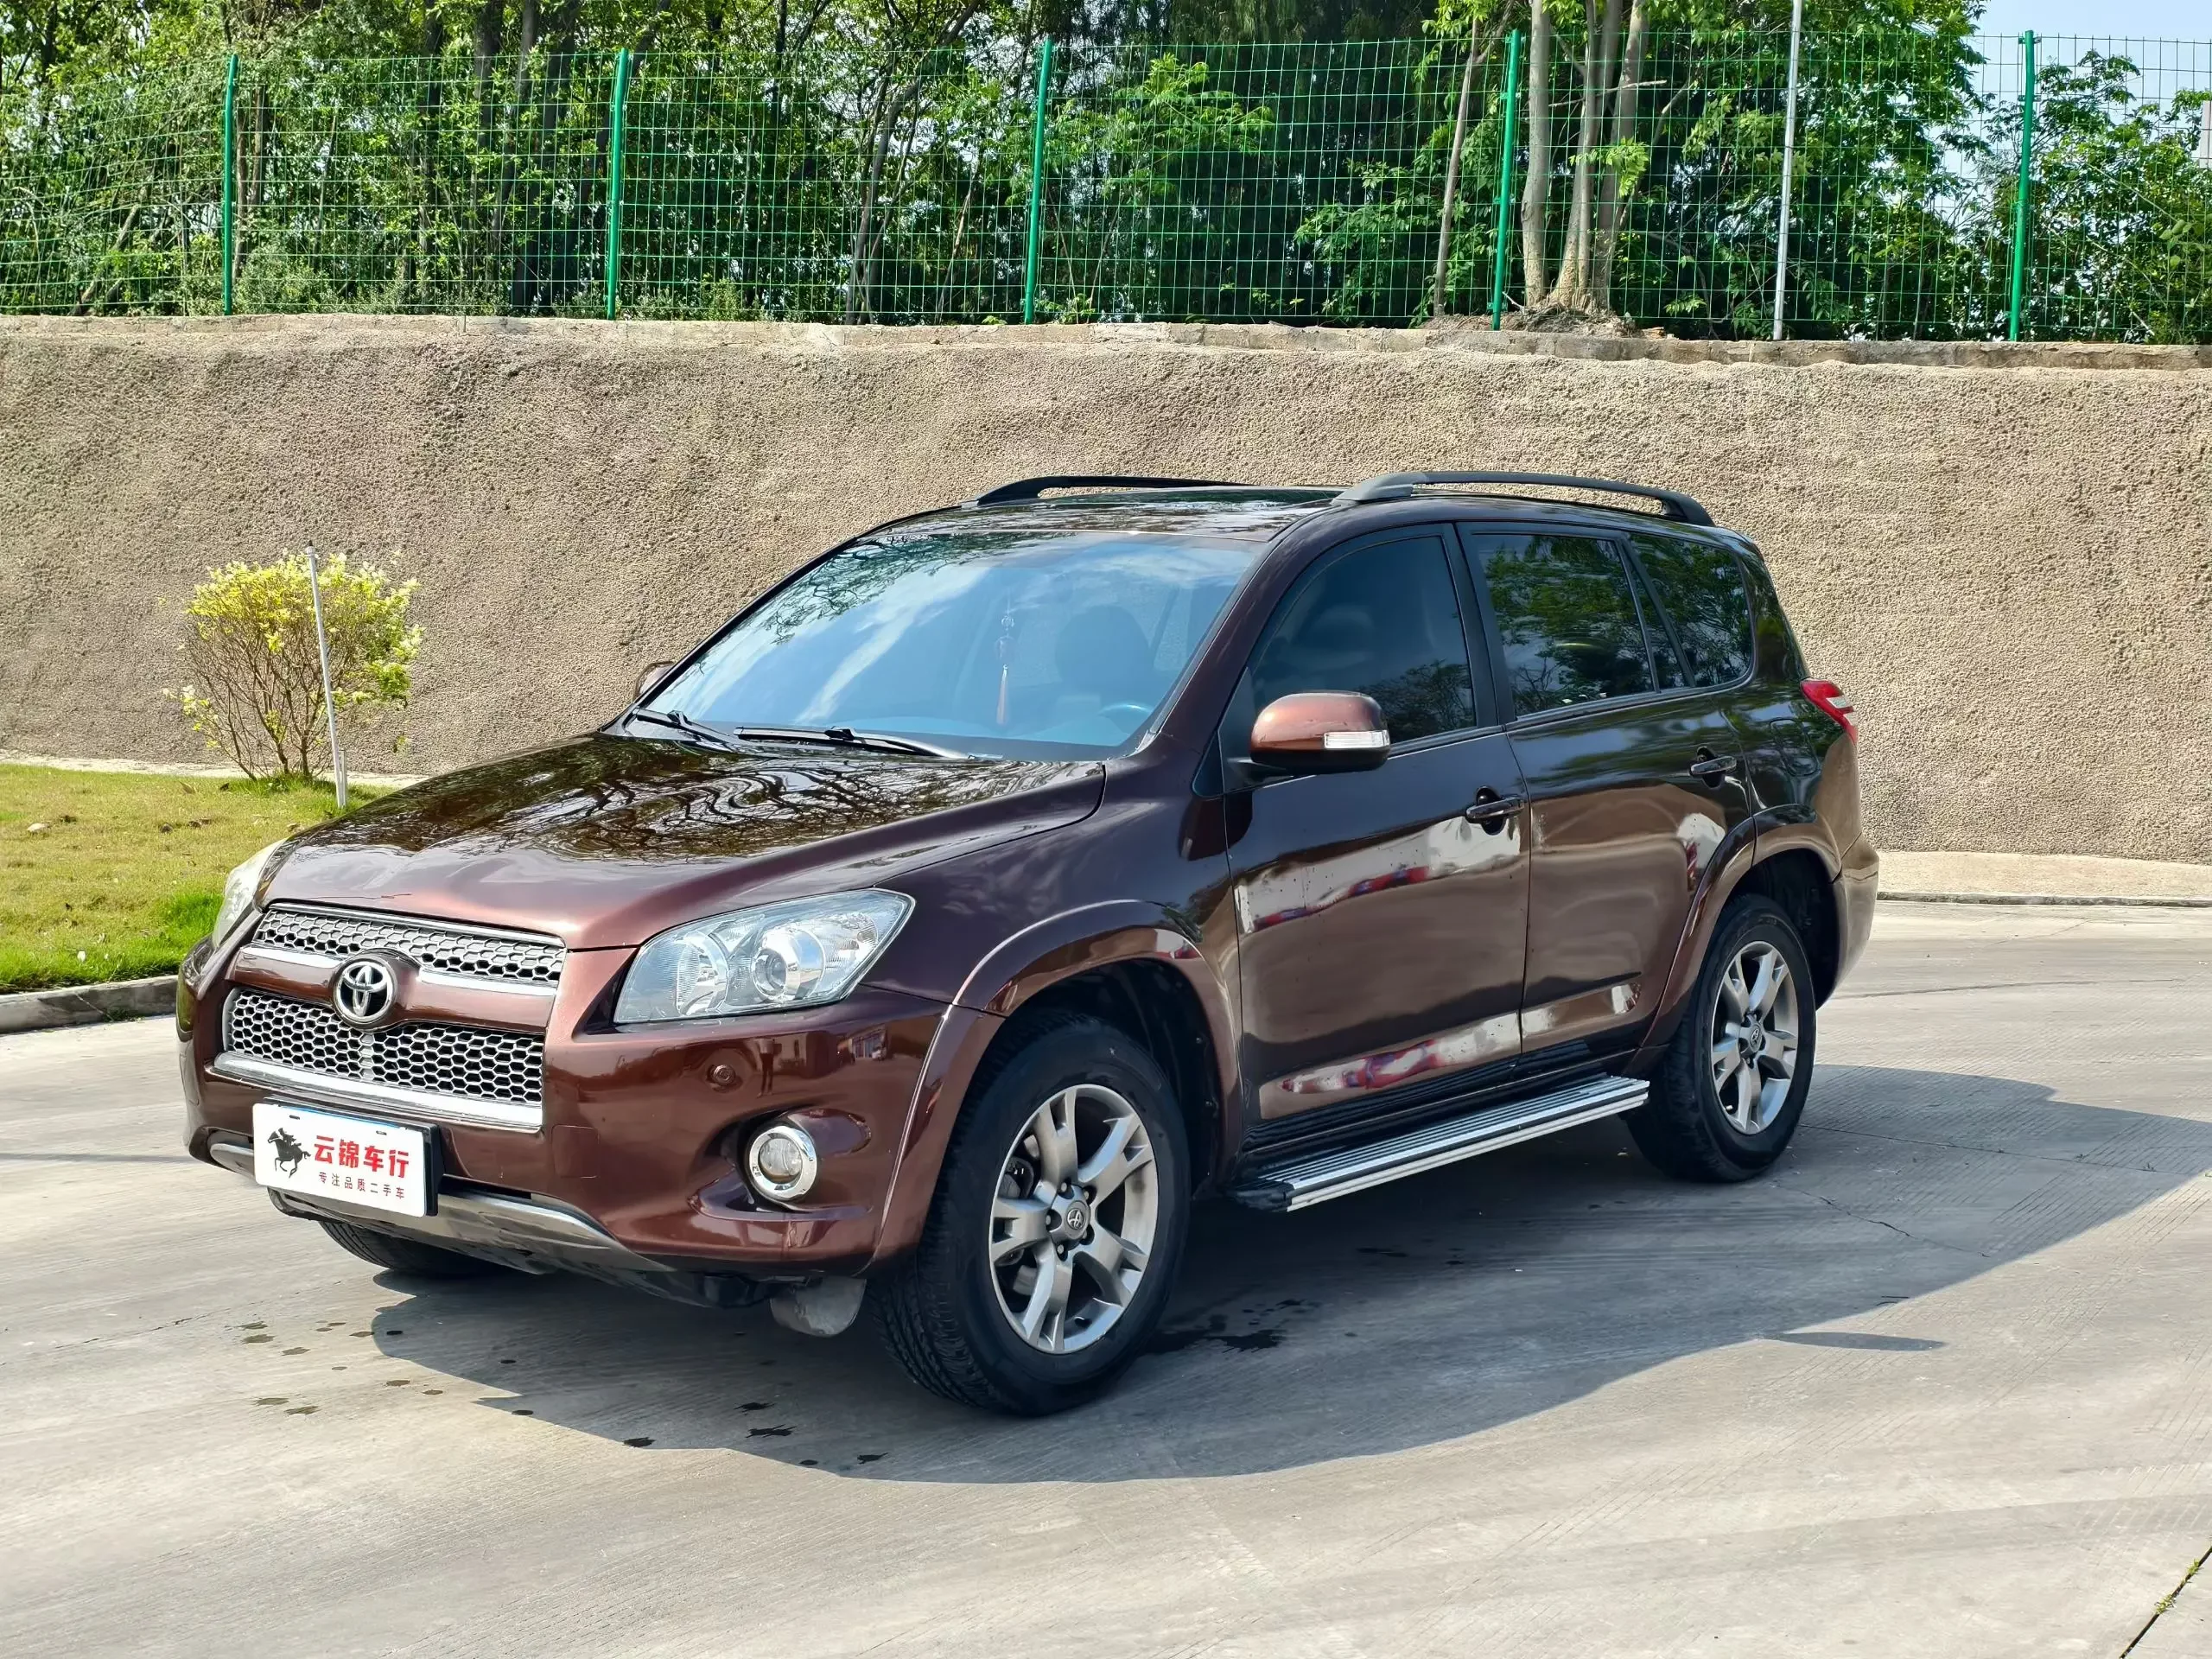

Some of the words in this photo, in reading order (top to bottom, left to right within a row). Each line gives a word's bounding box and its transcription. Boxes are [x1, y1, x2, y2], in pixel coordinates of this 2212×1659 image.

[314, 1135, 409, 1179] 云锦车行
[318, 1172, 404, 1199] 专注品质二手车
